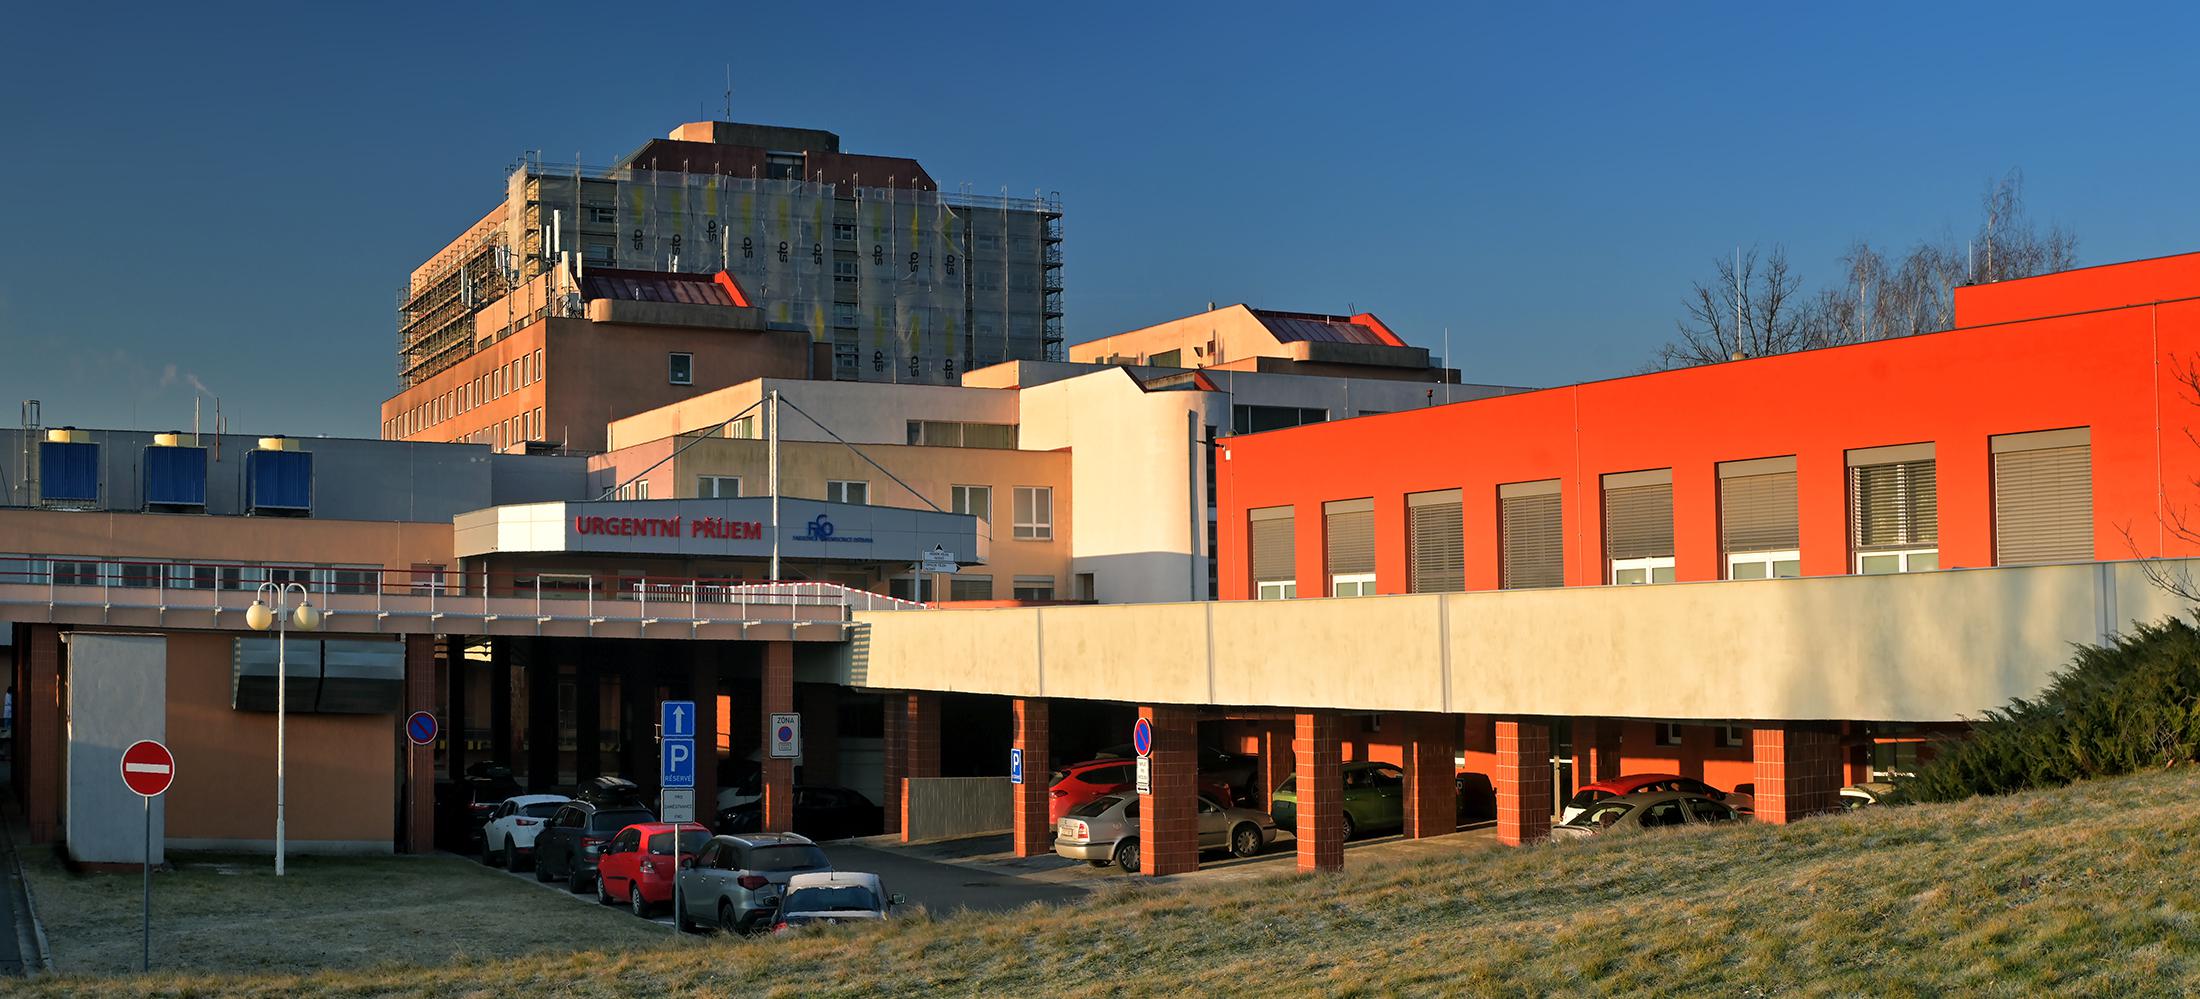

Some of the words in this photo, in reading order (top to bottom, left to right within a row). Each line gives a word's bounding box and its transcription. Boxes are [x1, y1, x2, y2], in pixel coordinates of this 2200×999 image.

[632, 229, 643, 250] sto
[706, 220, 717, 242] sto
[670, 234, 681, 255] sto
[742, 237, 753, 258] sto
[777, 241, 788, 262] sto
[812, 243, 822, 265] sto
[872, 245, 883, 265] sto
[908, 252, 919, 272] sto
[945, 254, 955, 275] sto
[872, 351, 883, 372] sto
[908, 356, 919, 377] sto
[943, 359, 954, 379] sto
[575, 515, 681, 537] URGENTNÍ
[691, 516, 762, 540] PŘÍJEM
[671, 745, 689, 772] P
[1013, 753, 1020, 772] P
